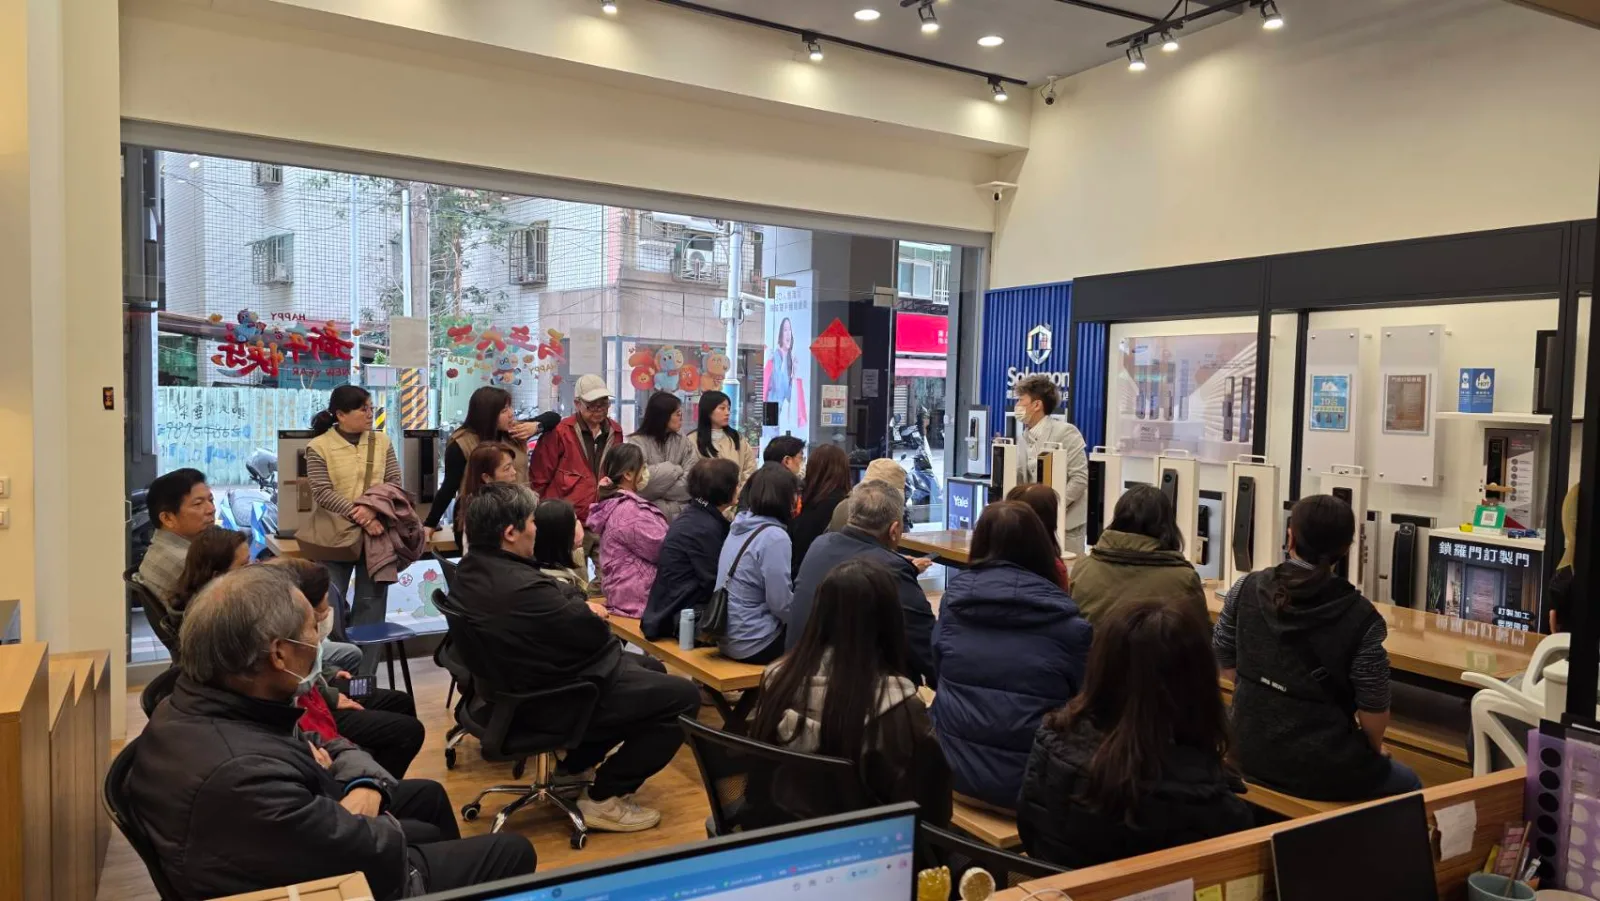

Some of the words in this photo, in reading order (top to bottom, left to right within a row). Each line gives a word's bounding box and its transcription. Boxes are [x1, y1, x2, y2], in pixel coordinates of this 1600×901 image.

[953, 495, 969, 508] Yale
[1438, 541, 1530, 567] 鎖羅門訂製門
[1498, 607, 1531, 620] 訂製加工
